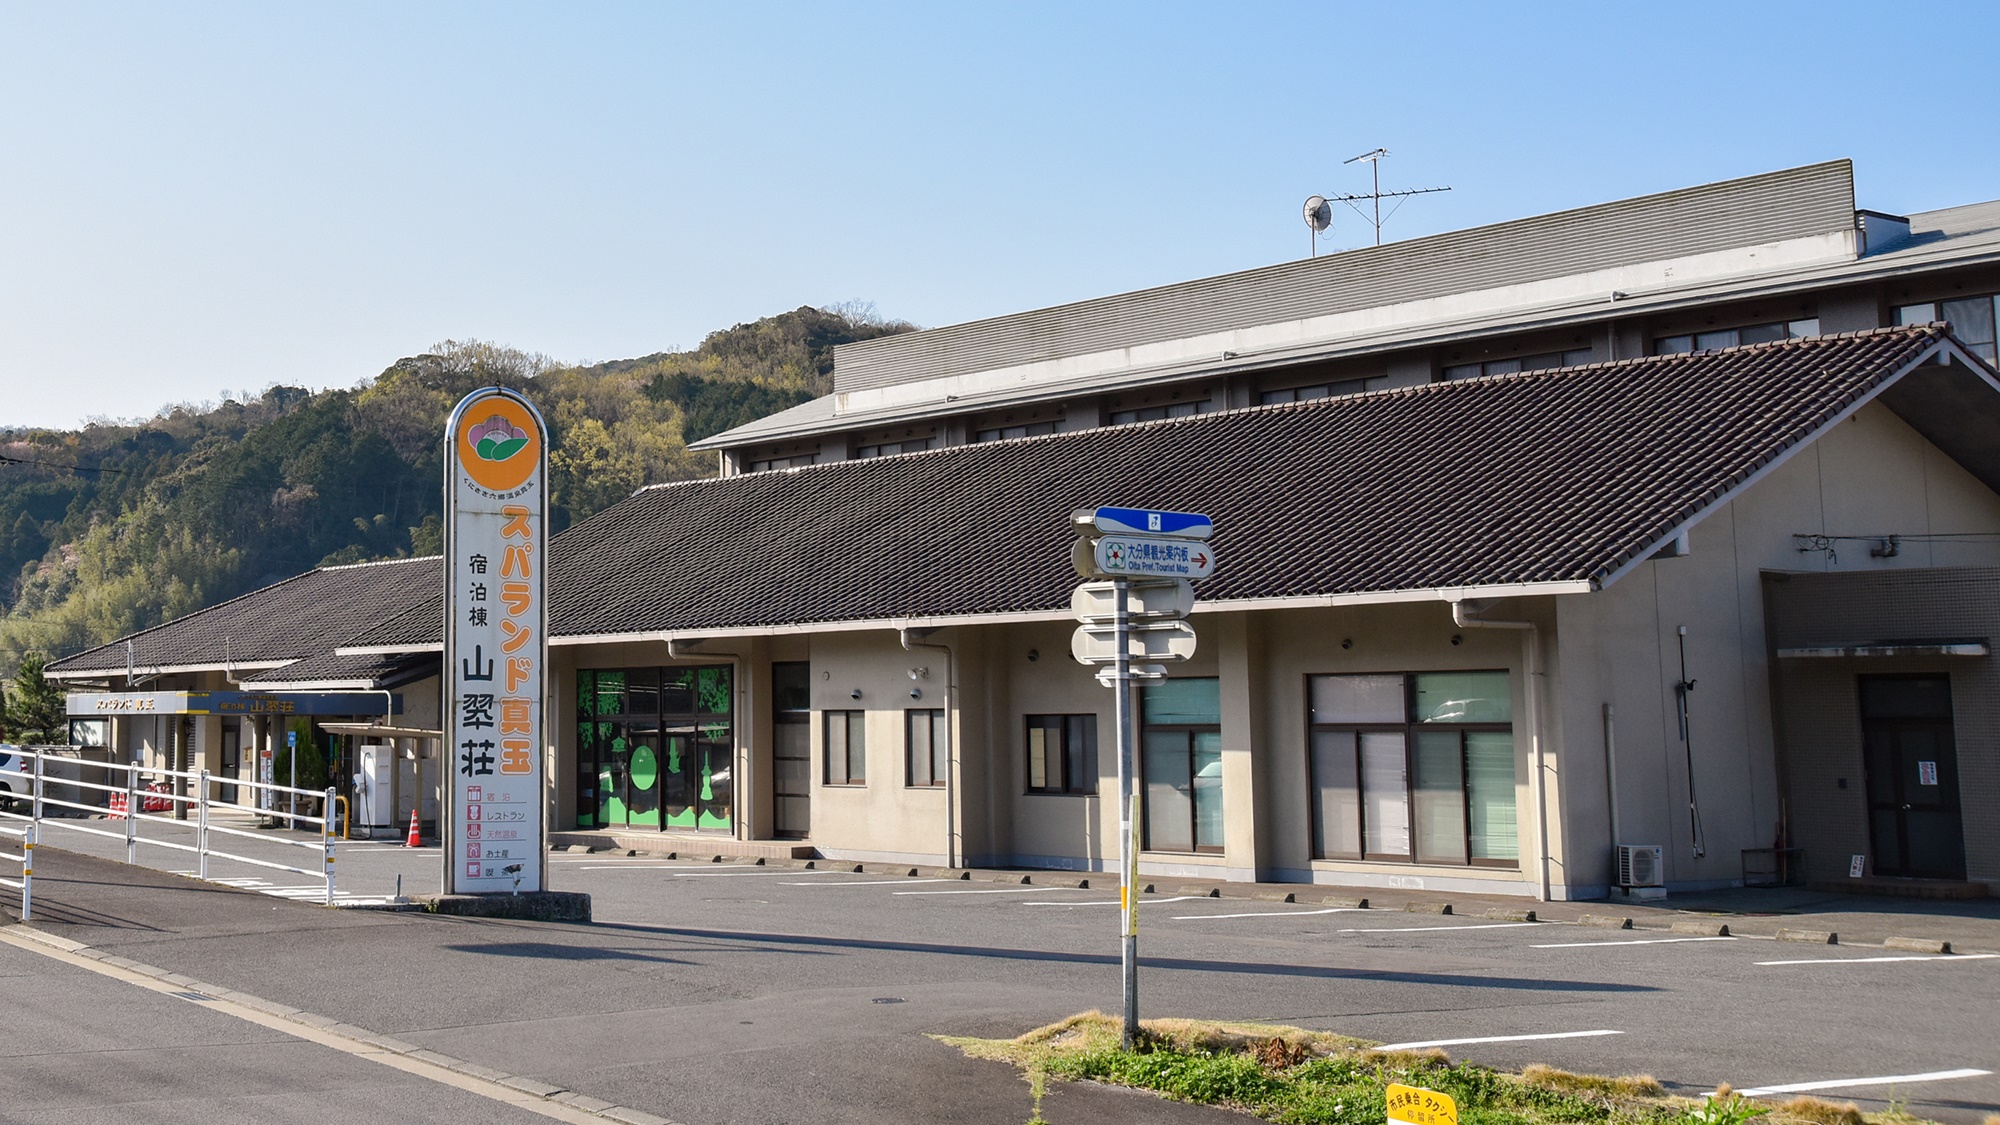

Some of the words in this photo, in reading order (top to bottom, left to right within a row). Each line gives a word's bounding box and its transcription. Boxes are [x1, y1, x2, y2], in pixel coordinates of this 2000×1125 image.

[1128, 544, 1189, 562] 大分県観光案内板
[1128, 561, 1141, 570] Oita
[1142, 562, 1156, 571] Pref.
[1155, 563, 1175, 572] Tourist
[1177, 564, 1189, 574] Map
[469, 553, 488, 628] 宿泊棟
[499, 504, 534, 776] スパランド真玉
[487, 811, 525, 821] レストラン
[486, 830, 518, 840] 天然温泉
[485, 849, 509, 859] お土産
[1388, 1091, 1421, 1112] 市民乗合
[1424, 1096, 1454, 1123] タクシー
